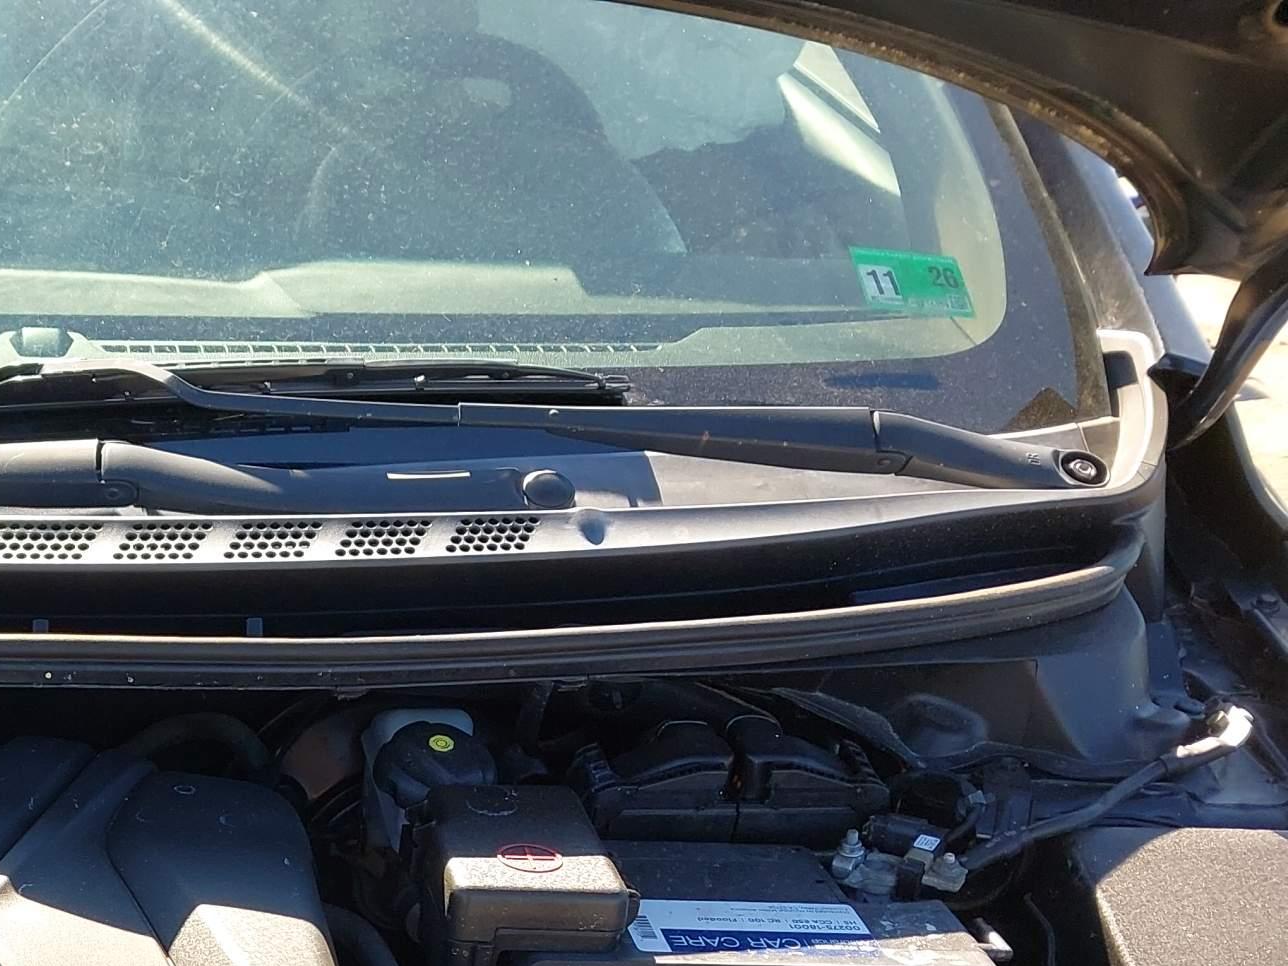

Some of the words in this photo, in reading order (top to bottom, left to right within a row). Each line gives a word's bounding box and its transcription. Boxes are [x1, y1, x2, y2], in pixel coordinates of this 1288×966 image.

[866, 269, 901, 295] 11
[927, 266, 959, 289] 26
[669, 935, 740, 949] CARE
[748, 936, 802, 949] CAR
